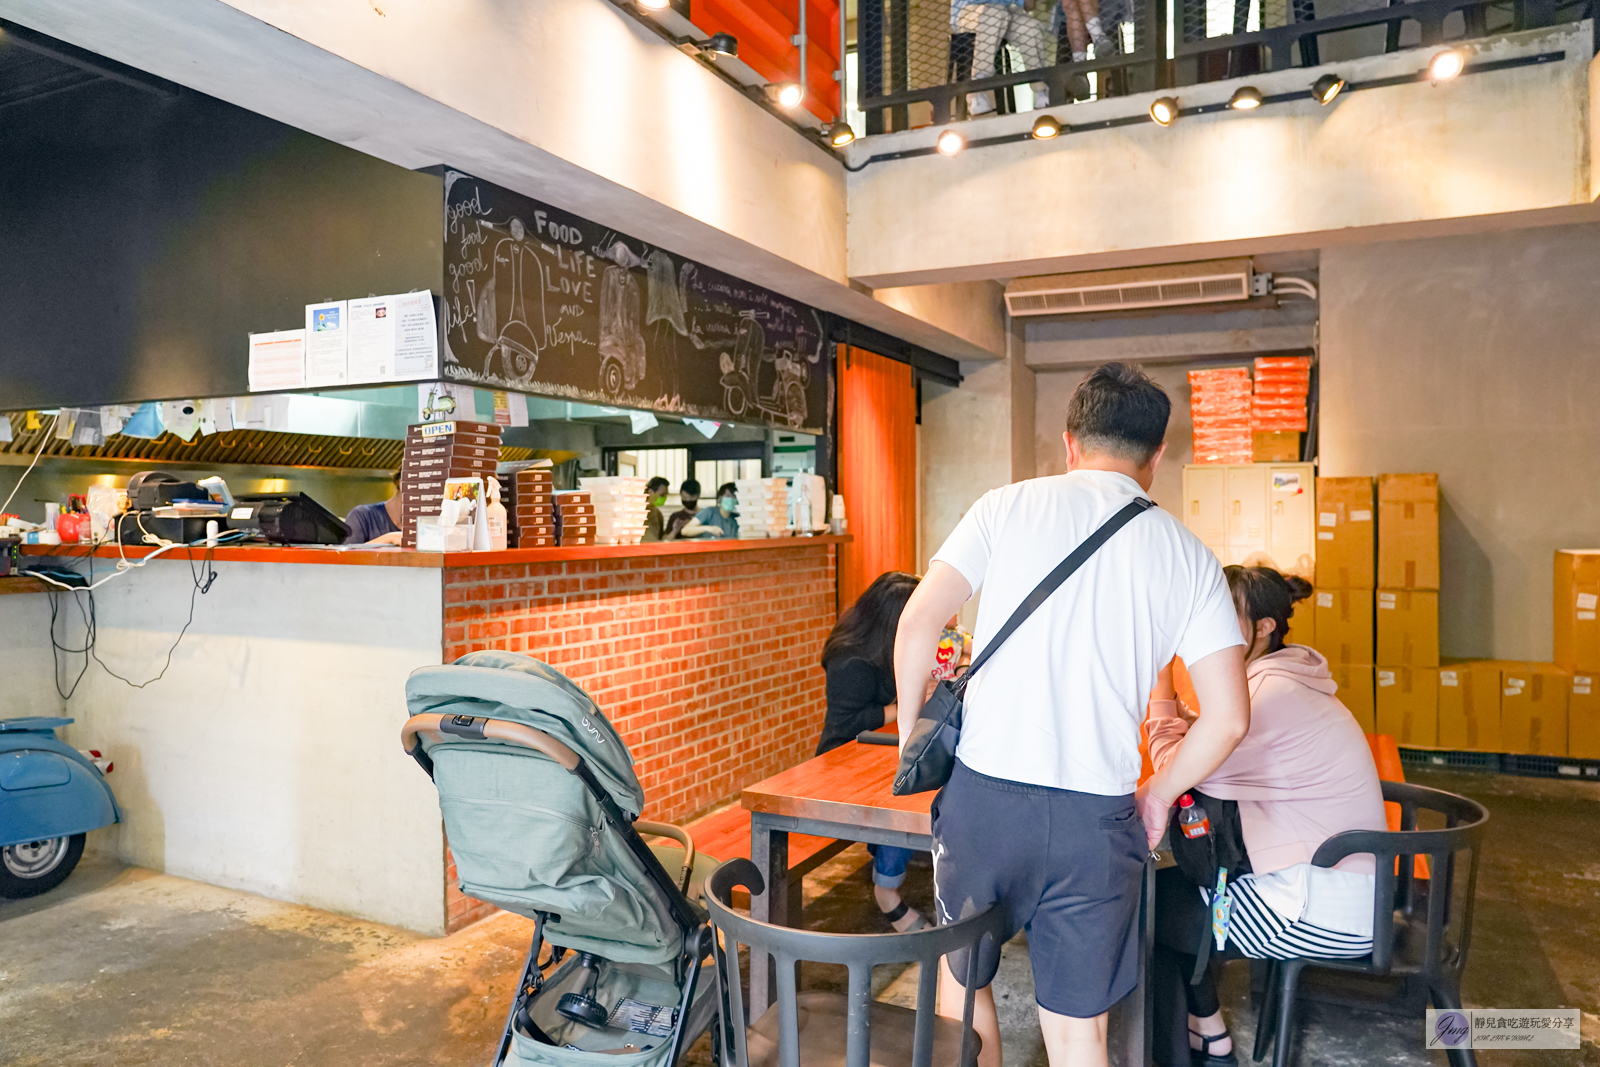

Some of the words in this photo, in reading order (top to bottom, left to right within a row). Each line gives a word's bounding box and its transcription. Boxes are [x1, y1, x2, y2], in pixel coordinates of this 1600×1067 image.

[447, 187, 492, 233] good
[534, 210, 583, 245] FOOD
[449, 248, 488, 293] good
[545, 265, 593, 303] LOVE
[560, 304, 585, 317] AND
[424, 424, 452, 436] OPEN
